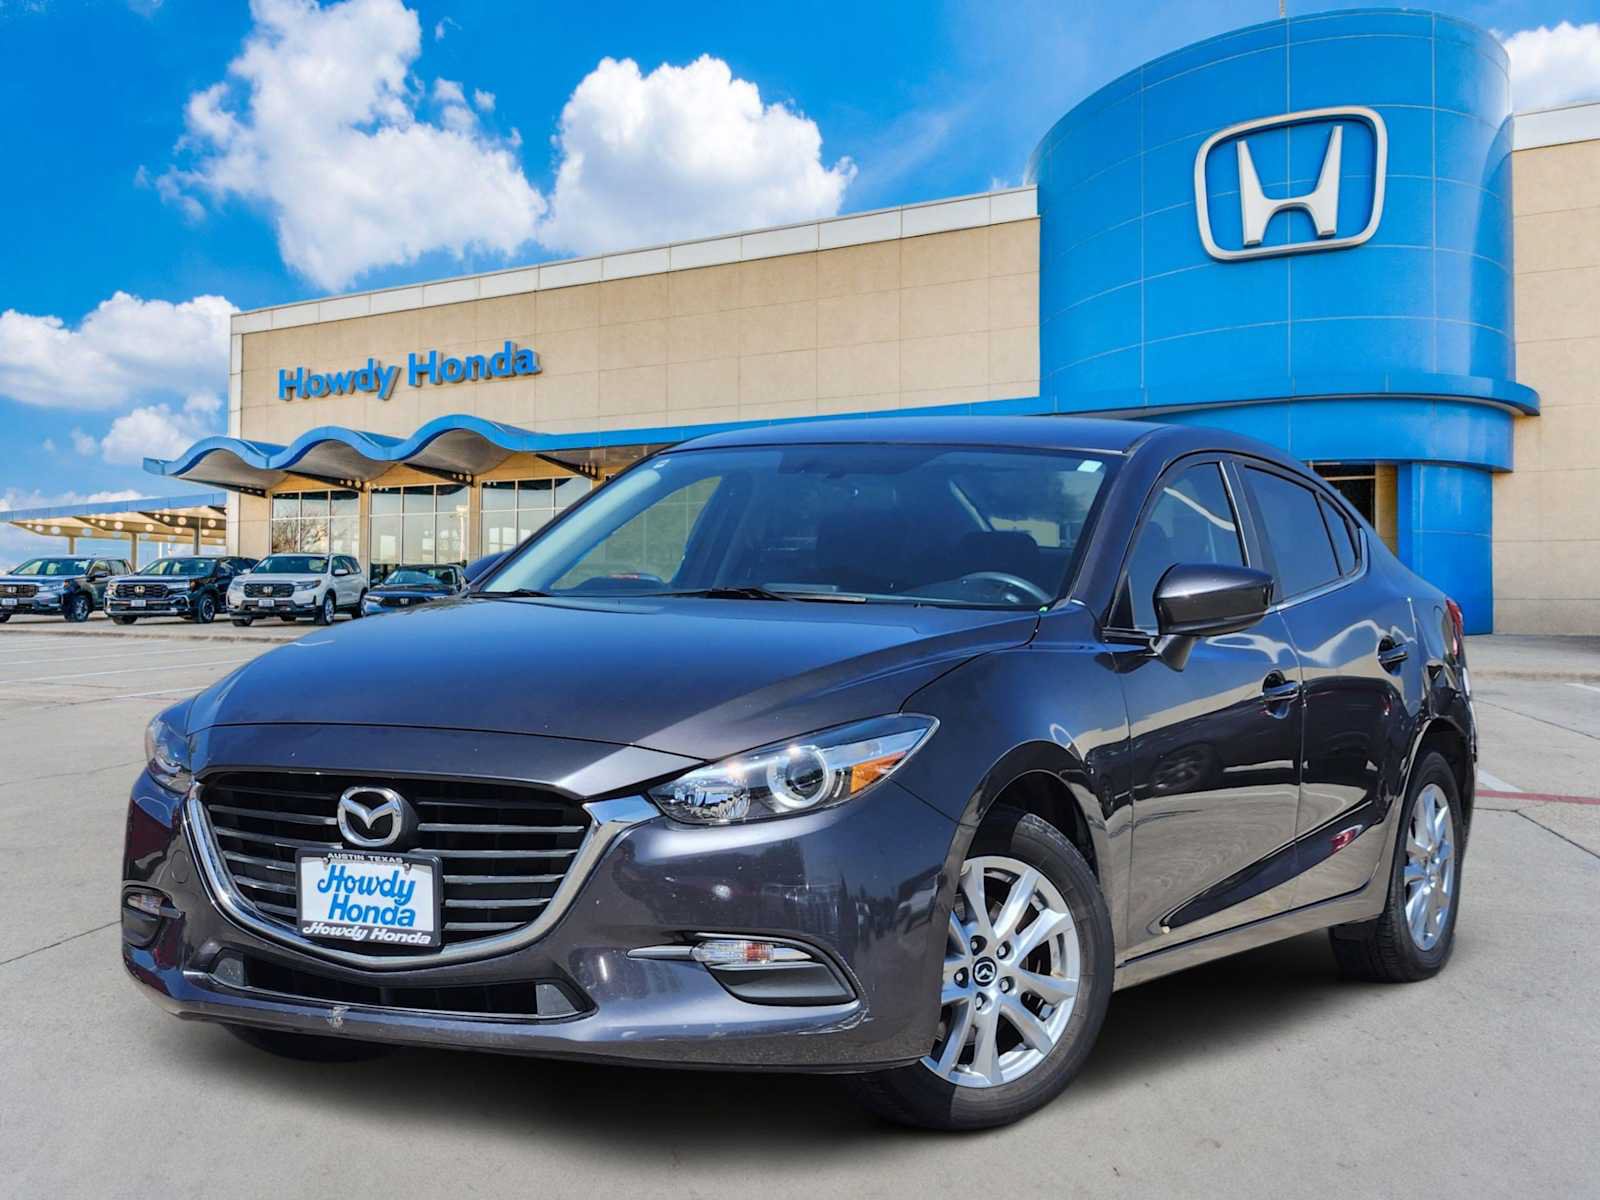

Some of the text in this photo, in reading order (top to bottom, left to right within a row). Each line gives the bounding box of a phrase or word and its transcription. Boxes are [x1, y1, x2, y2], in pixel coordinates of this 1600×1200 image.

[278, 340, 542, 401] Howdy Honda
[327, 852, 403, 864] AUSTIN TEXAS
[317, 864, 416, 906] Howdy
[328, 893, 416, 927] Honda
[302, 922, 432, 945] Howdy Honda
